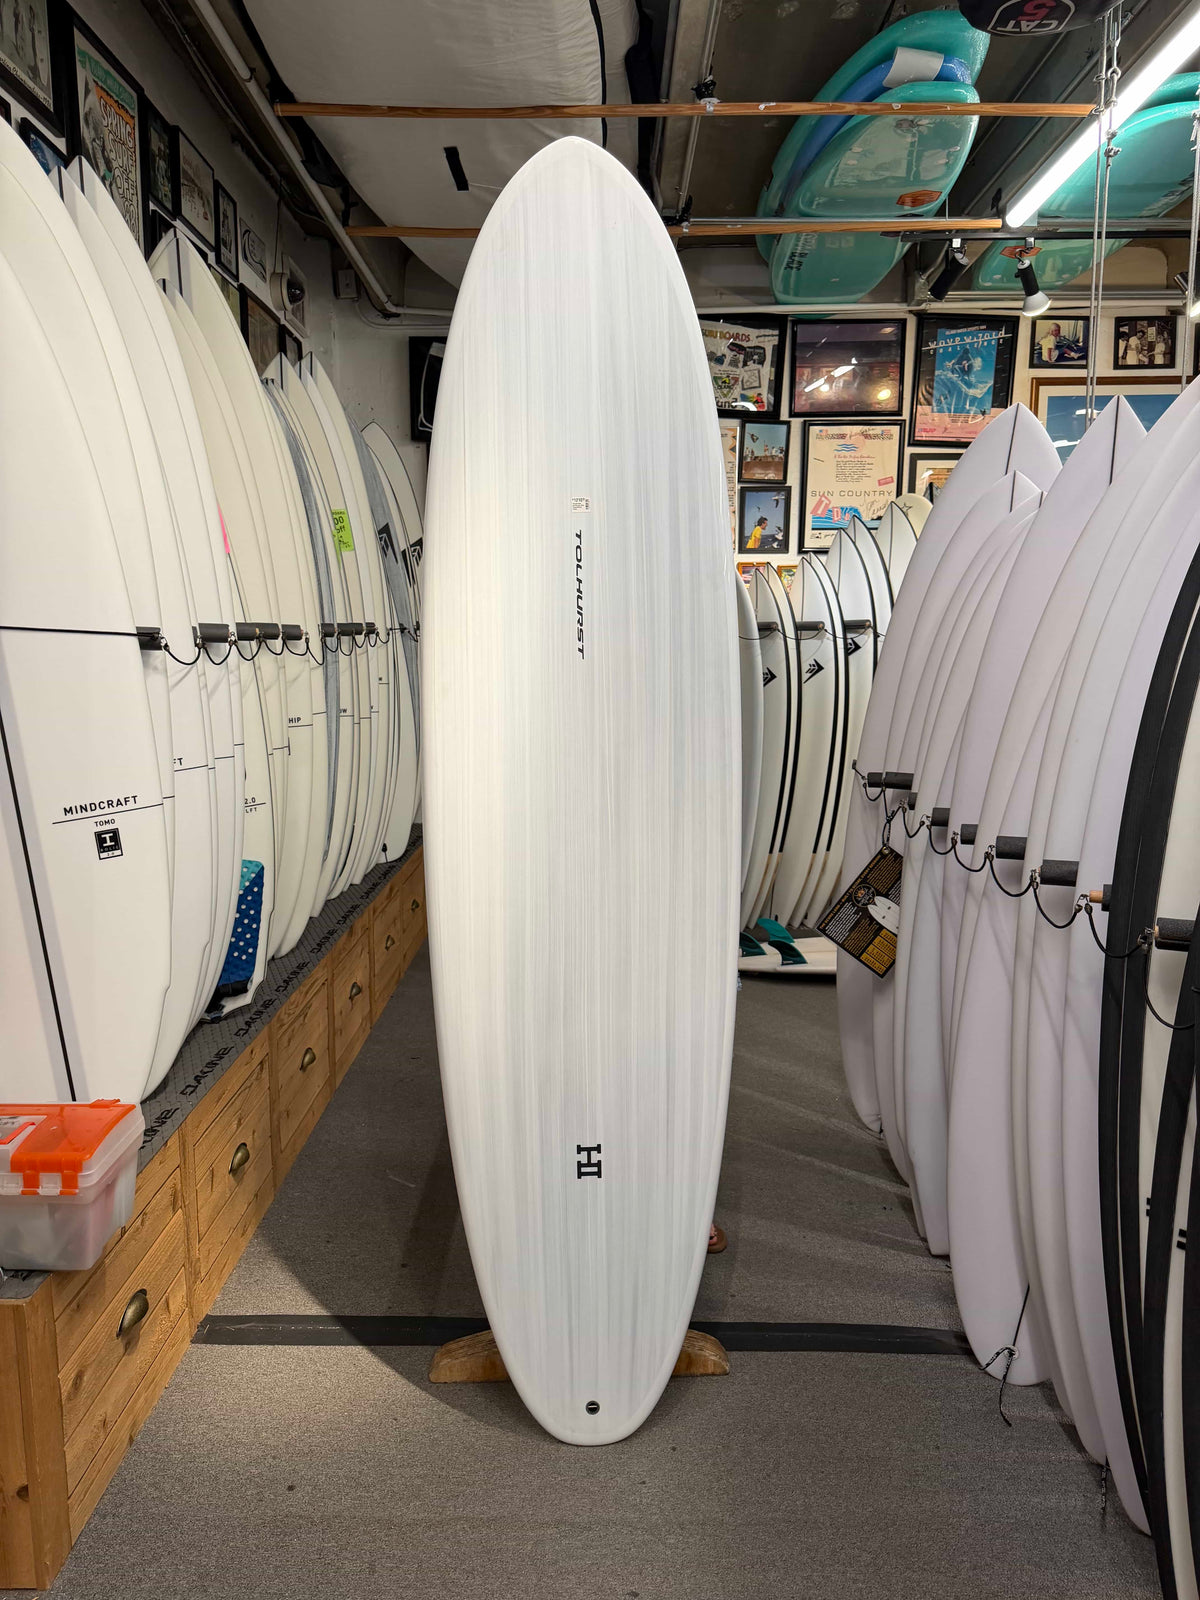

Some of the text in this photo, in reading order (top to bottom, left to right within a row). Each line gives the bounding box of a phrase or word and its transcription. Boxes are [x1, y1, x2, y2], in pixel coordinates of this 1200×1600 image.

[100, 96, 136, 150] SPRING
[810, 490, 894, 499] SUN COUNTRY
[575, 529, 585, 661] TOLHURST
[63, 795, 139, 817] MINDCRAFT
[94, 818, 117, 828] TOMO
[274, 961, 311, 993] DAKINE
[233, 997, 277, 1038] DAKINE
[179, 1045, 235, 1096] DAKINE
